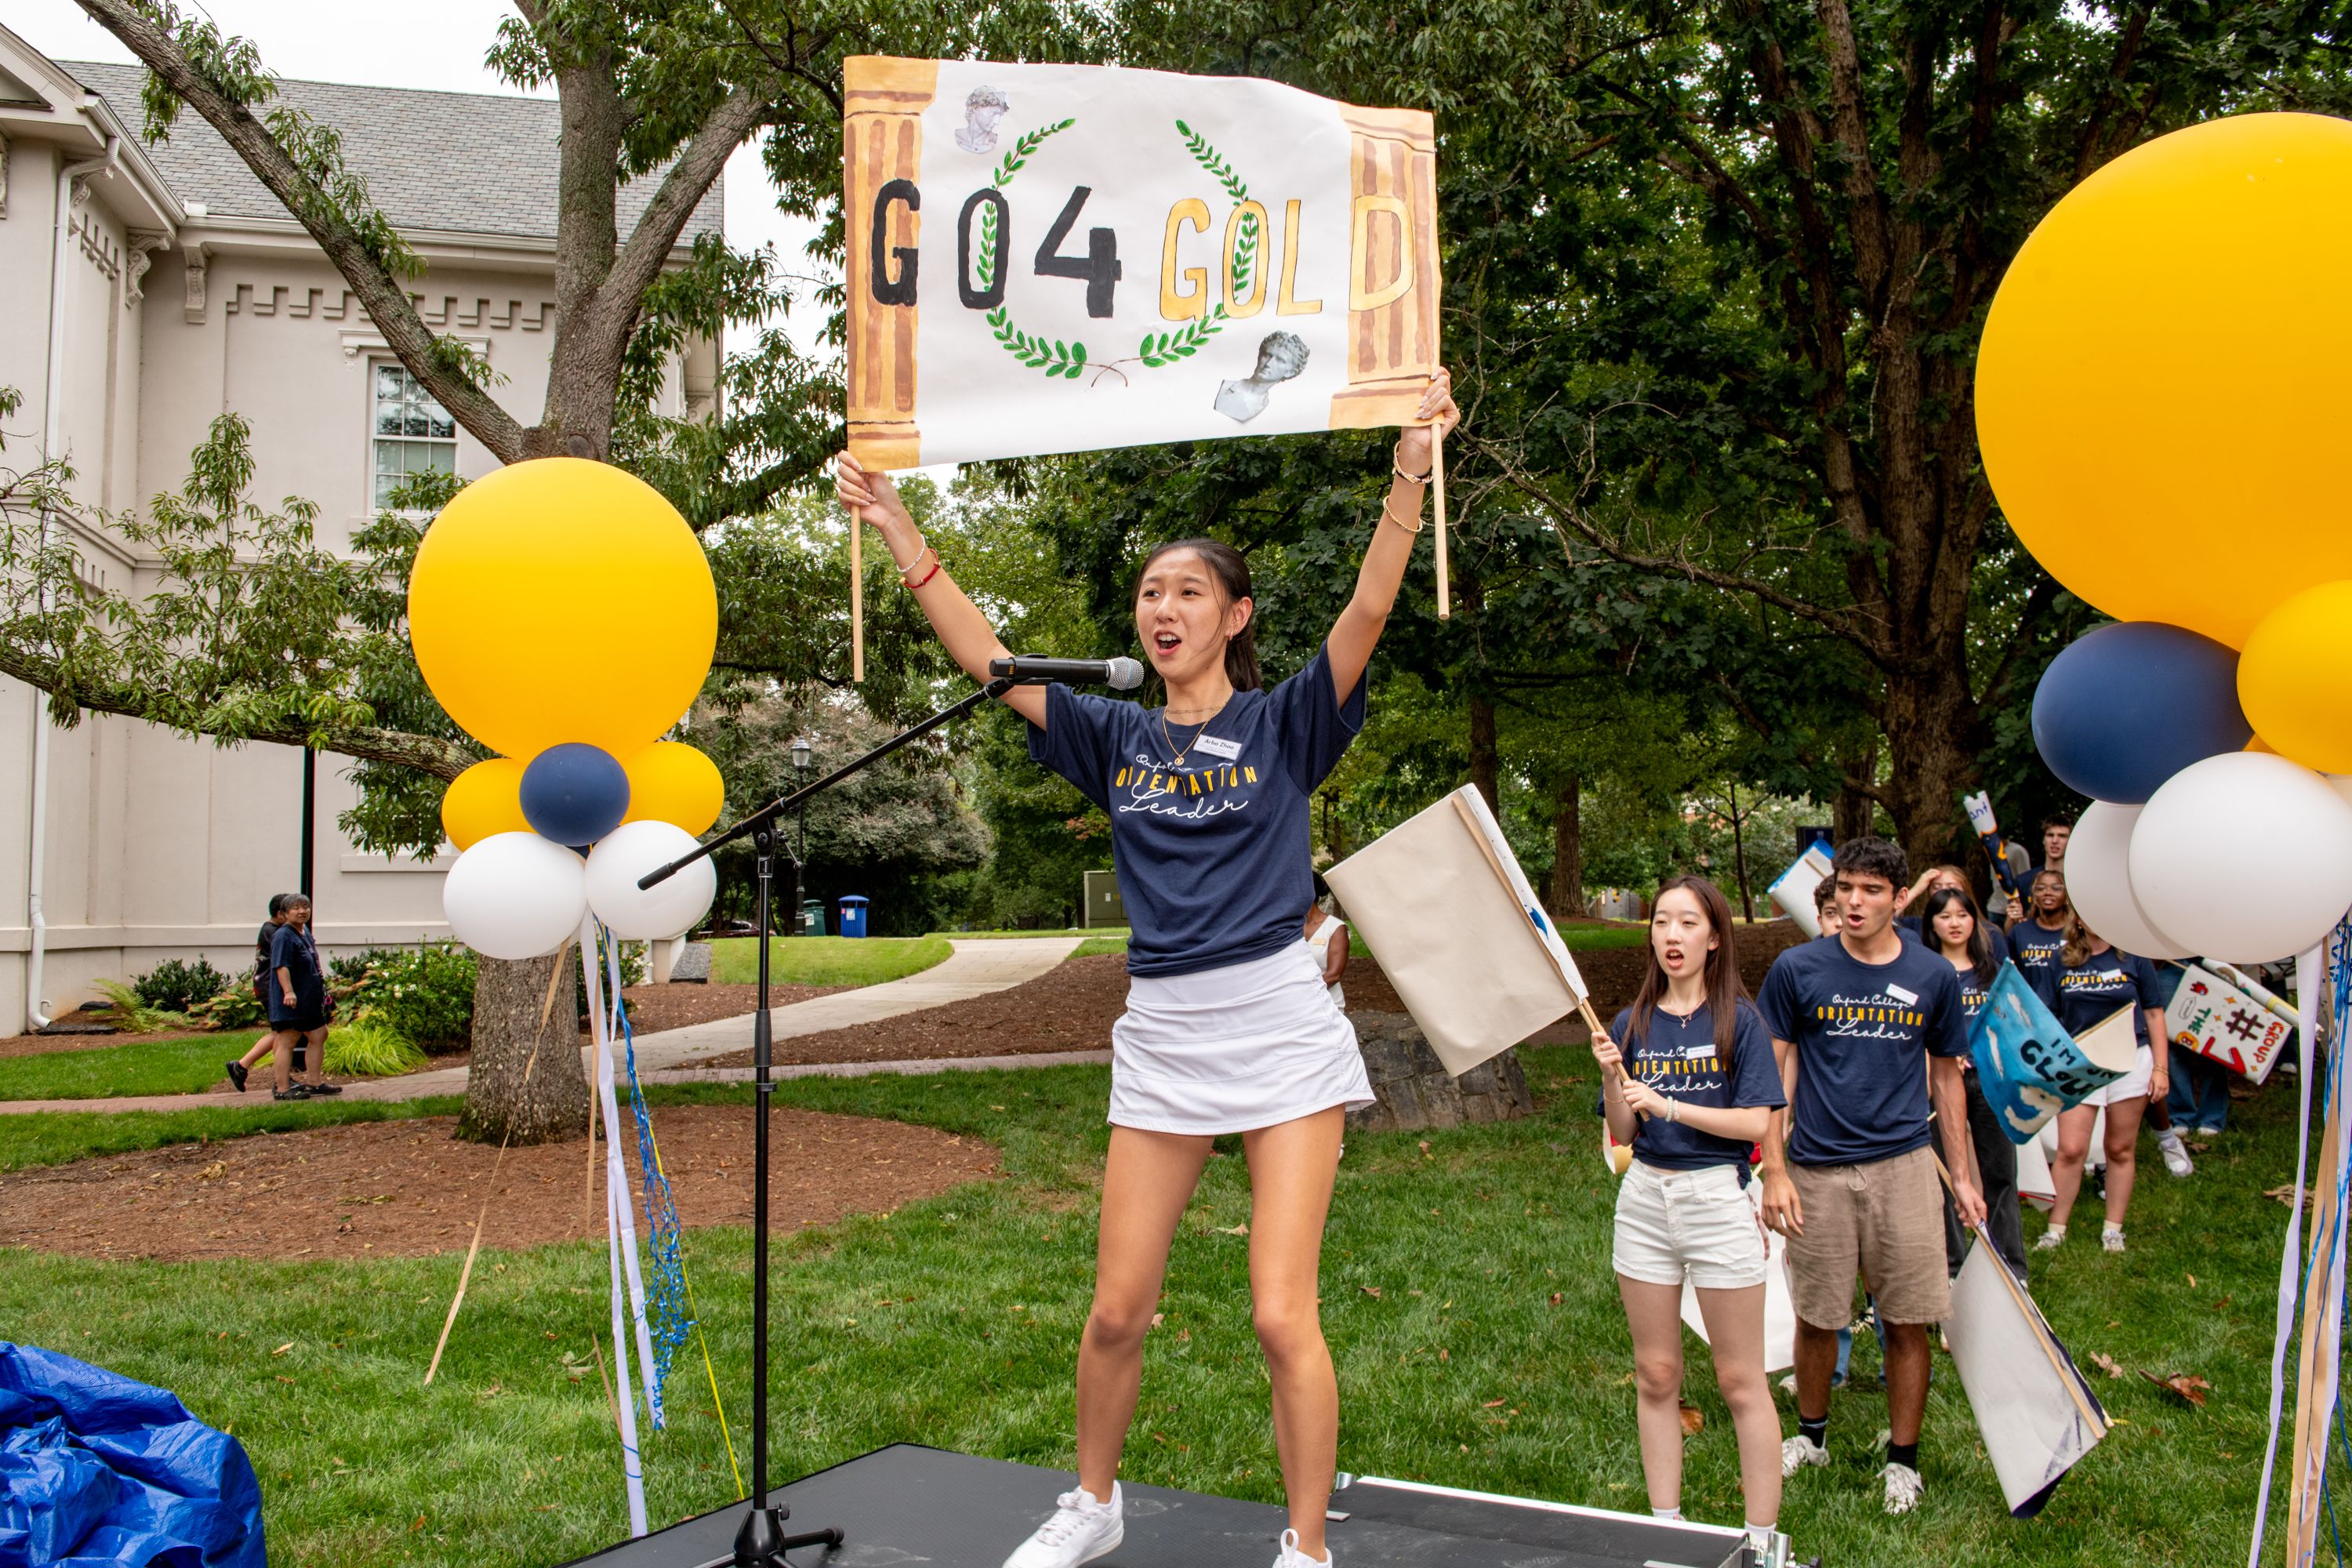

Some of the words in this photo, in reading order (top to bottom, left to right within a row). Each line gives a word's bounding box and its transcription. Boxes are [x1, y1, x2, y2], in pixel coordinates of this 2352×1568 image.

[1159, 195, 1414, 321] GOLD
[1119, 782, 1249, 819] Leader
[1832, 993, 1871, 1007] Oxford
[1817, 1006, 1924, 1026] ORIENTATION
[2187, 1007, 2212, 1036] THE
[1826, 1017, 1912, 1040] Leader
[2252, 1021, 2285, 1064] GROUP
[1637, 1048, 1676, 1061] Oxford
[1632, 1057, 1727, 1076] RIENTATIO
[2020, 1039, 2095, 1096] CLOU
[1641, 1070, 1722, 1092] Leader
